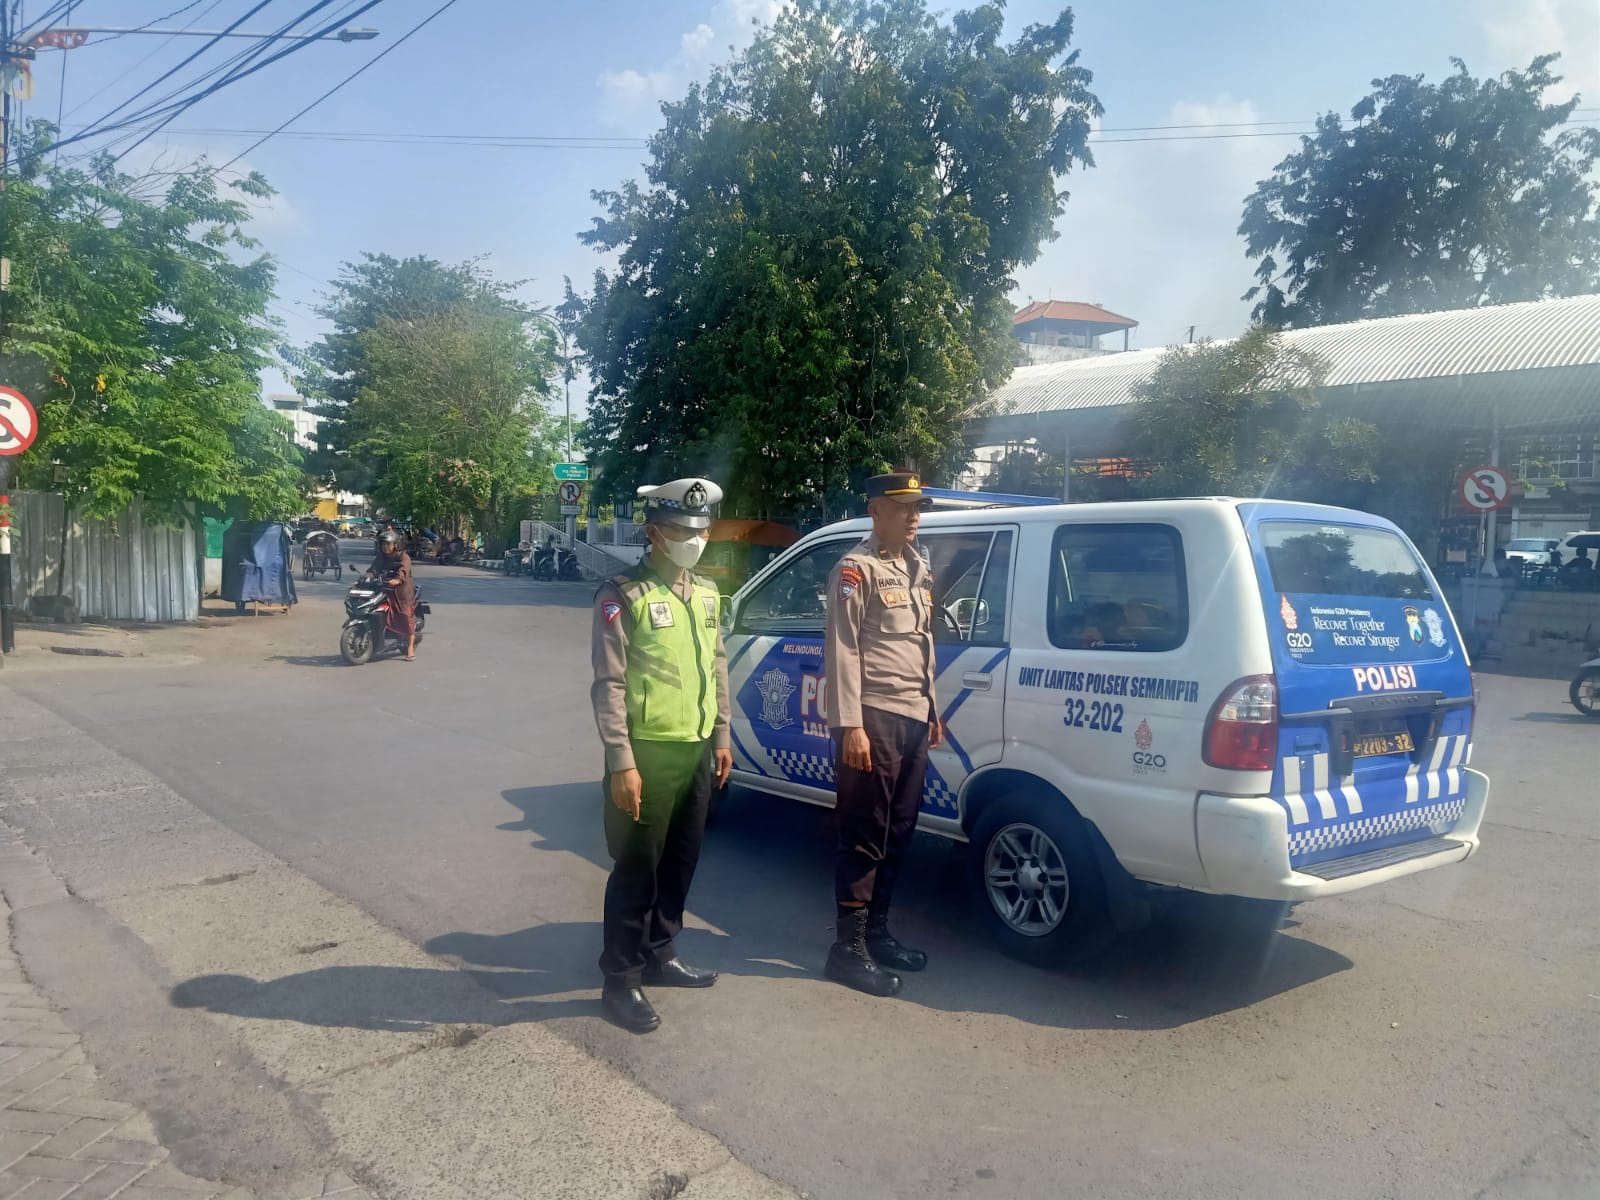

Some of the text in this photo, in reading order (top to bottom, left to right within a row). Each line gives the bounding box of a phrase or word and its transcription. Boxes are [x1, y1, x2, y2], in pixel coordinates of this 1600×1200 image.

[1474, 474, 1495, 503] S
[1313, 616, 1385, 635] Recover Together
[1286, 632, 1312, 648] G20
[1333, 632, 1400, 651] Recover Stronger
[1018, 666, 1200, 703] UNIT LANTAS POLSEK SEMAMPIR
[1352, 665, 1417, 692] POLISI
[1063, 697, 1124, 733] 32-202
[1133, 751, 1166, 768] G20
